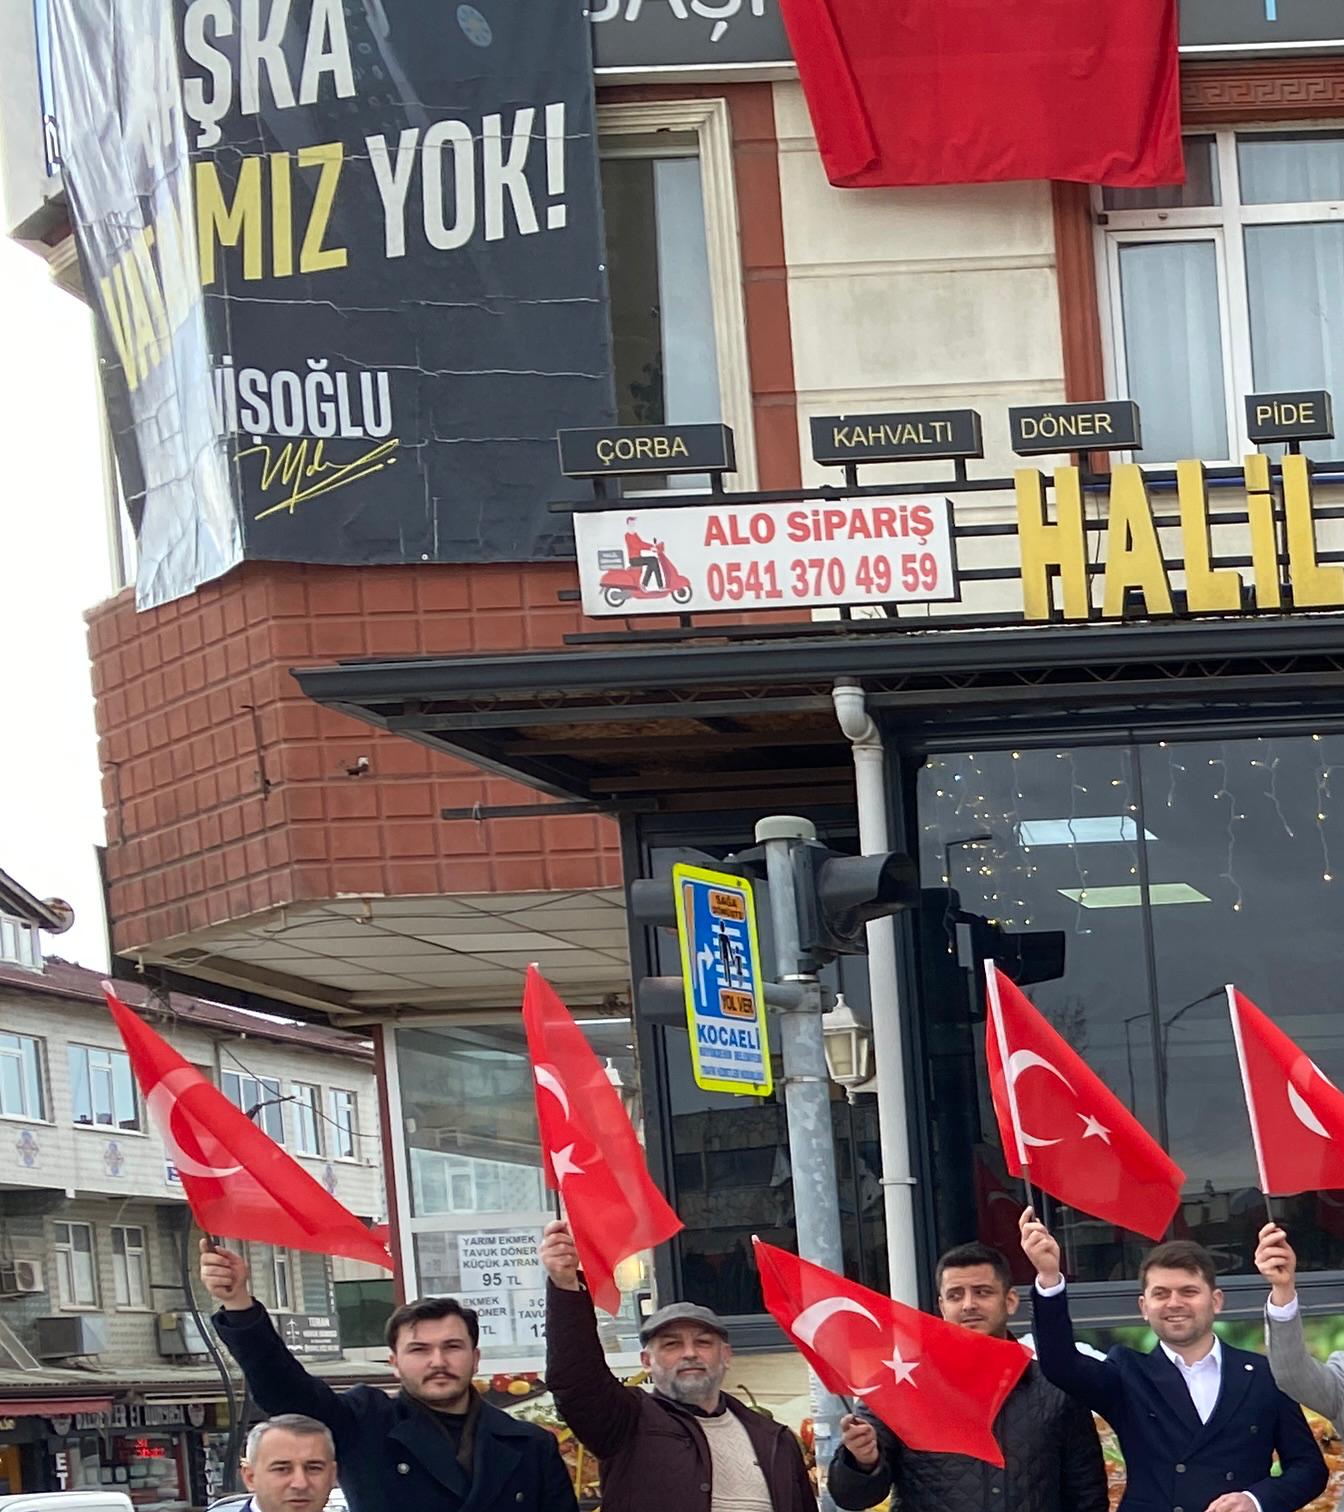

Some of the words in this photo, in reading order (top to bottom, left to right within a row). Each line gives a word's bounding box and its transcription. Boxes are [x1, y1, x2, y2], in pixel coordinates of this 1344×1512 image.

[371, 103, 566, 259] YOK!
[1020, 411, 1112, 440] DÖNER
[1255, 399, 1315, 427] PİDE
[833, 421, 953, 448] KAHVALTI
[596, 436, 689, 466] ÇORBA
[703, 512, 775, 546] ALO
[707, 560, 783, 601] 0541
[790, 556, 846, 598] 370
[855, 554, 892, 594] 49
[901, 552, 938, 593] 59
[697, 1022, 761, 1050] KOCAELİ
[462, 1236, 496, 1246] YARIM
[499, 1235, 536, 1245] EKMEK
[463, 1248, 498, 1257] TAVUK
[463, 1258, 500, 1270] KÜÇÜK
[502, 1257, 539, 1267] AYRAN
[482, 1273, 502, 1286] 95
[506, 1275, 522, 1286] TL
[518, 1310, 545, 1319] TAVU
[480, 1325, 497, 1335] TL
